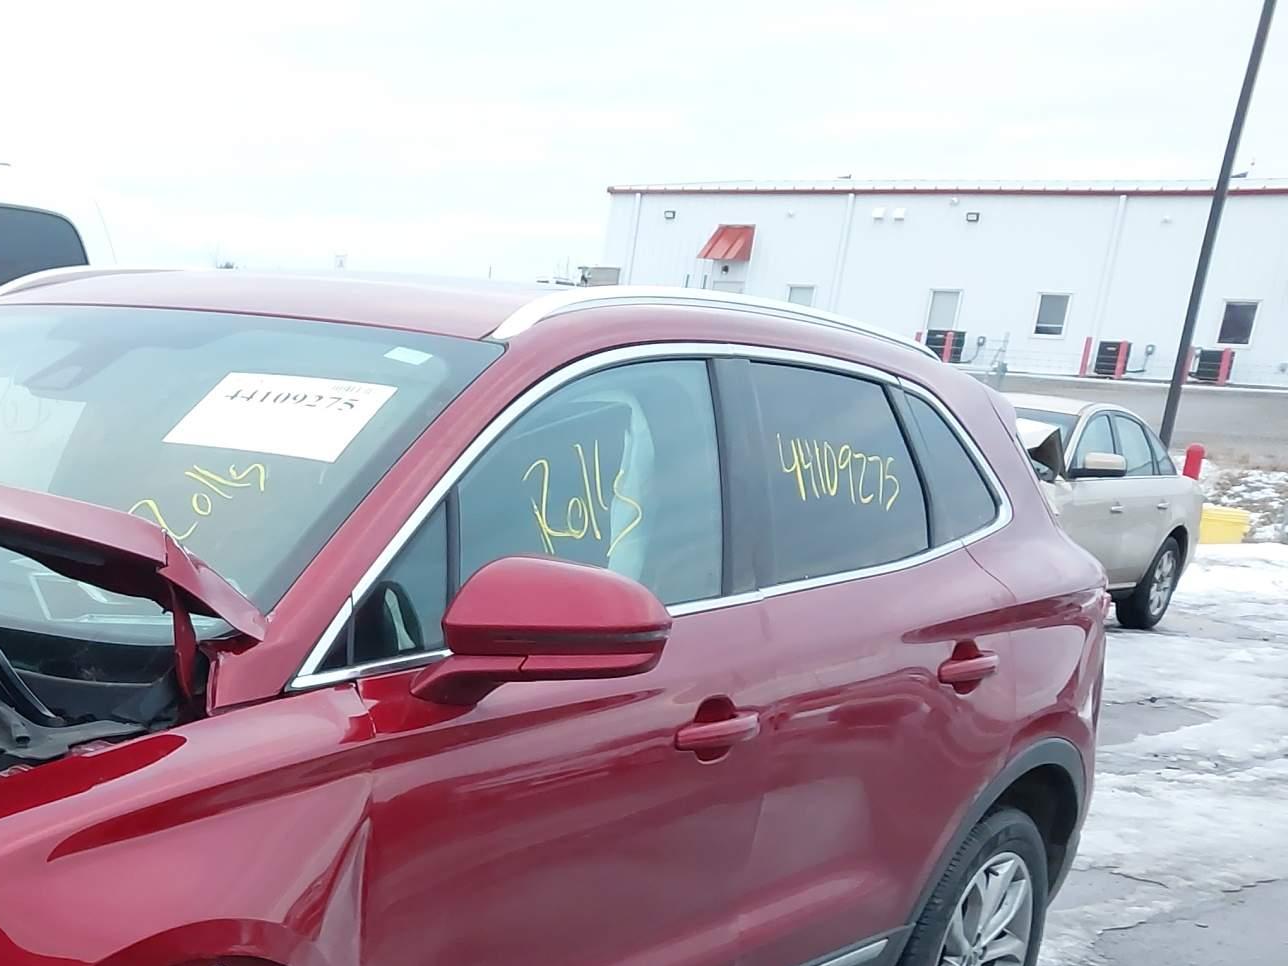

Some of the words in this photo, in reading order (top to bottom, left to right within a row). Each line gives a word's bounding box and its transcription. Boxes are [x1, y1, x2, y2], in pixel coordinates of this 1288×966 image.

[224, 387, 360, 411] 44109275
[522, 439, 643, 557] Rolls
[776, 432, 901, 512] 44109275
